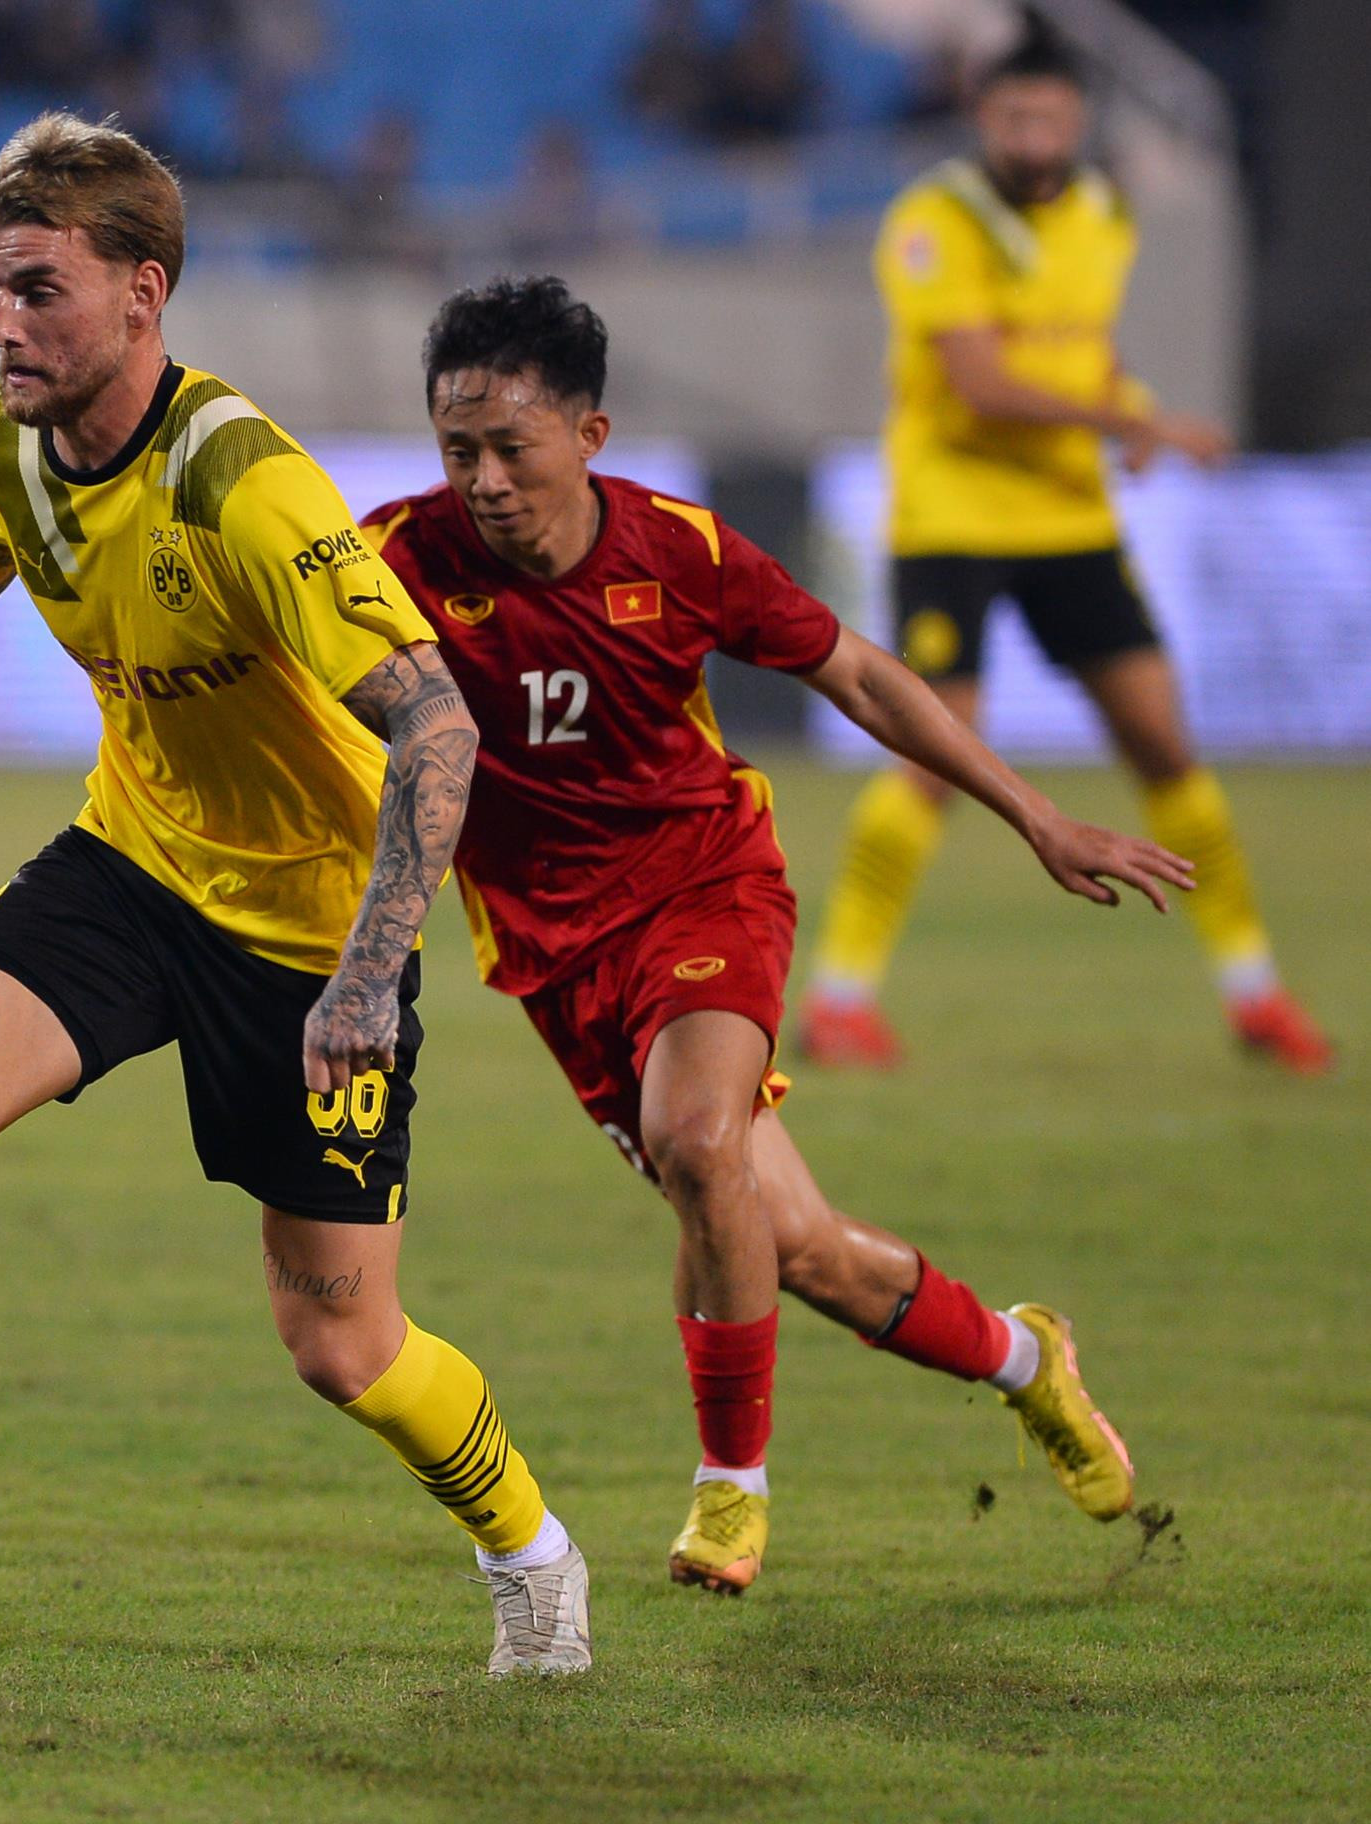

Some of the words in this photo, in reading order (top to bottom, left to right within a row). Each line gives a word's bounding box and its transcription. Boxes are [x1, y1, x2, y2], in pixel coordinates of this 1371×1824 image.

[153, 554, 192, 593] BVB
[290, 529, 363, 581] ROWE
[167, 592, 182, 606] 09
[520, 669, 589, 745] 12
